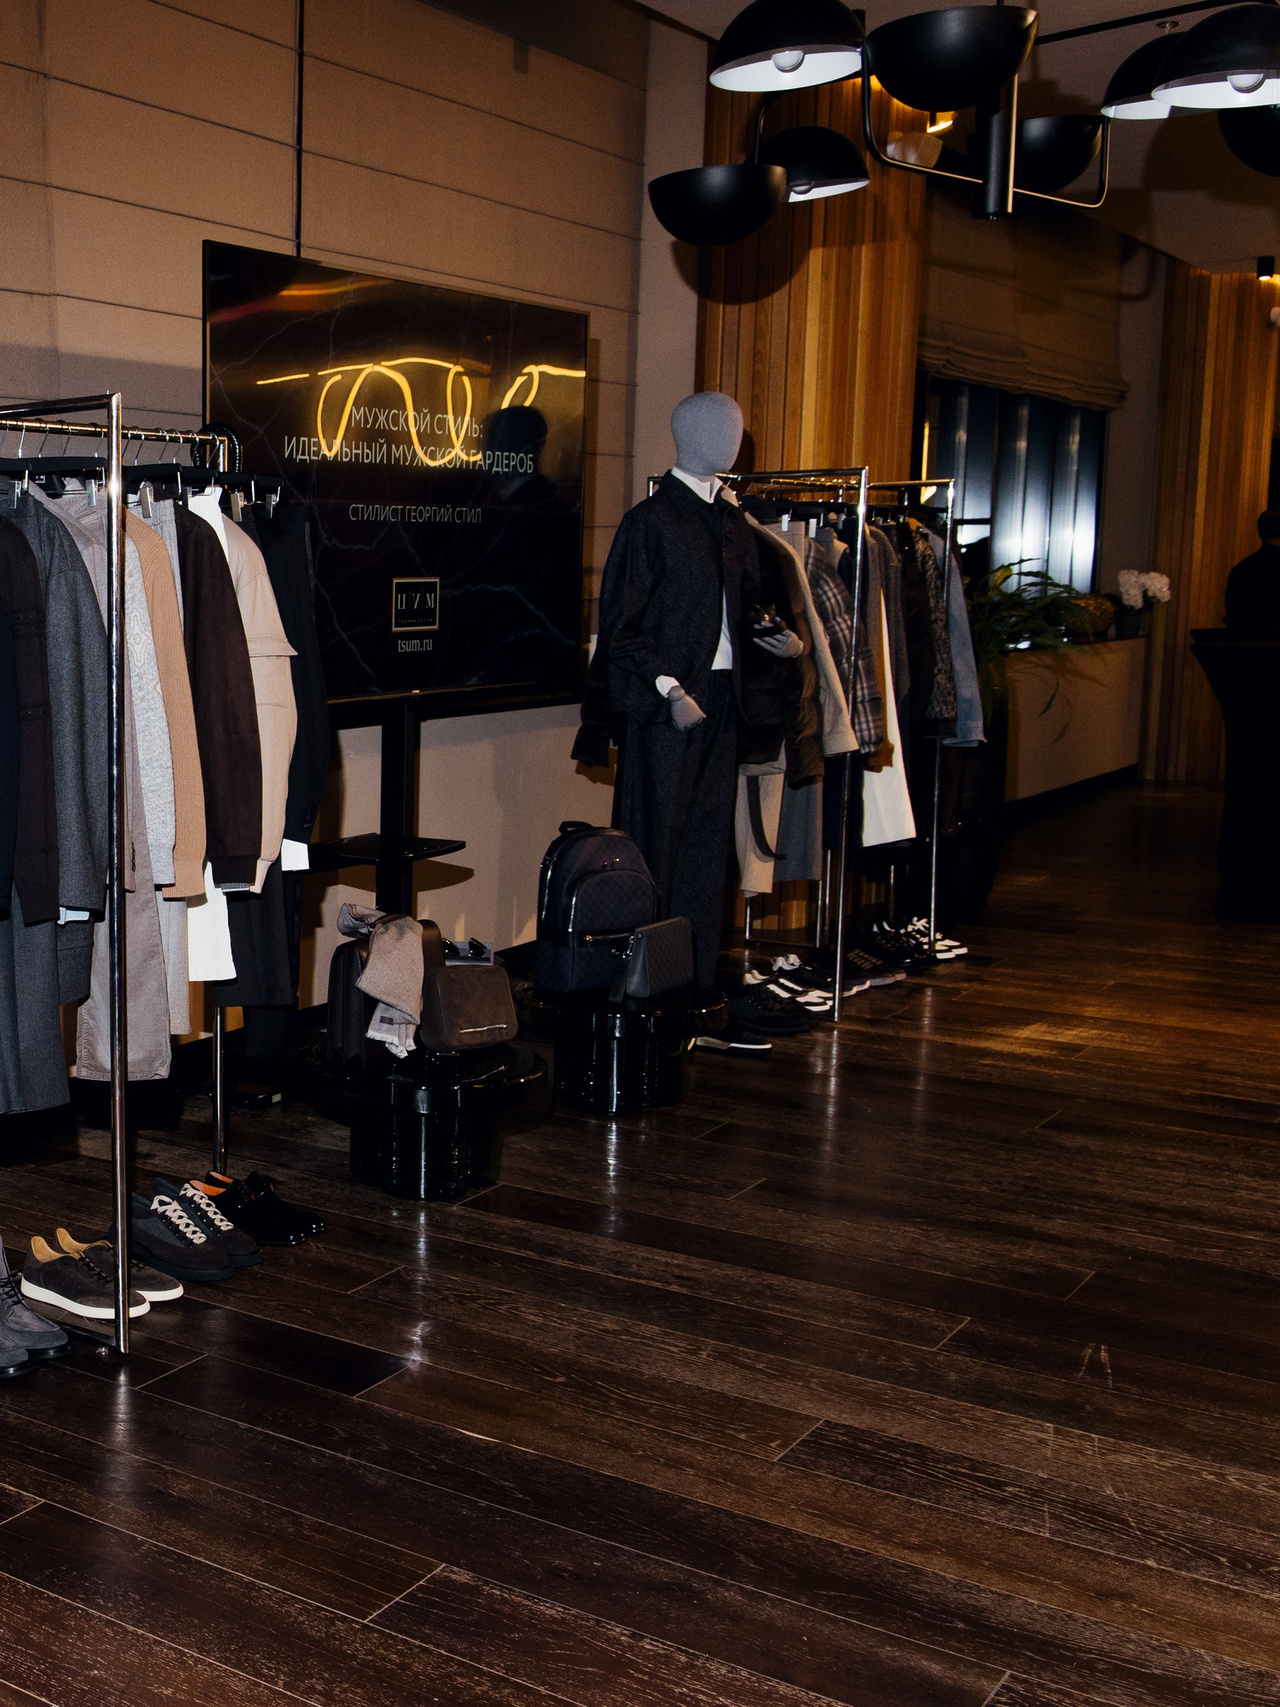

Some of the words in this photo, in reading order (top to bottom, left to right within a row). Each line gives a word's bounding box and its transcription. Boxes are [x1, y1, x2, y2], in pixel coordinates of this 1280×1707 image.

[351, 405, 431, 434] МУЖСКОЙ
[433, 413, 483, 438] СТИЛЬ:
[284, 435, 387, 464] ИДЕАЛЬНЫЙ
[391, 443, 466, 469] МУЖСКОЙ
[469, 451, 534, 474] ГАРДЕРОБ
[349, 504, 403, 522] СТИЛИСТ
[405, 503, 452, 523] ГЕОРГИЙ
[454, 507, 482, 524] СТИЛ
[397, 638, 433, 653] tsum.ru
